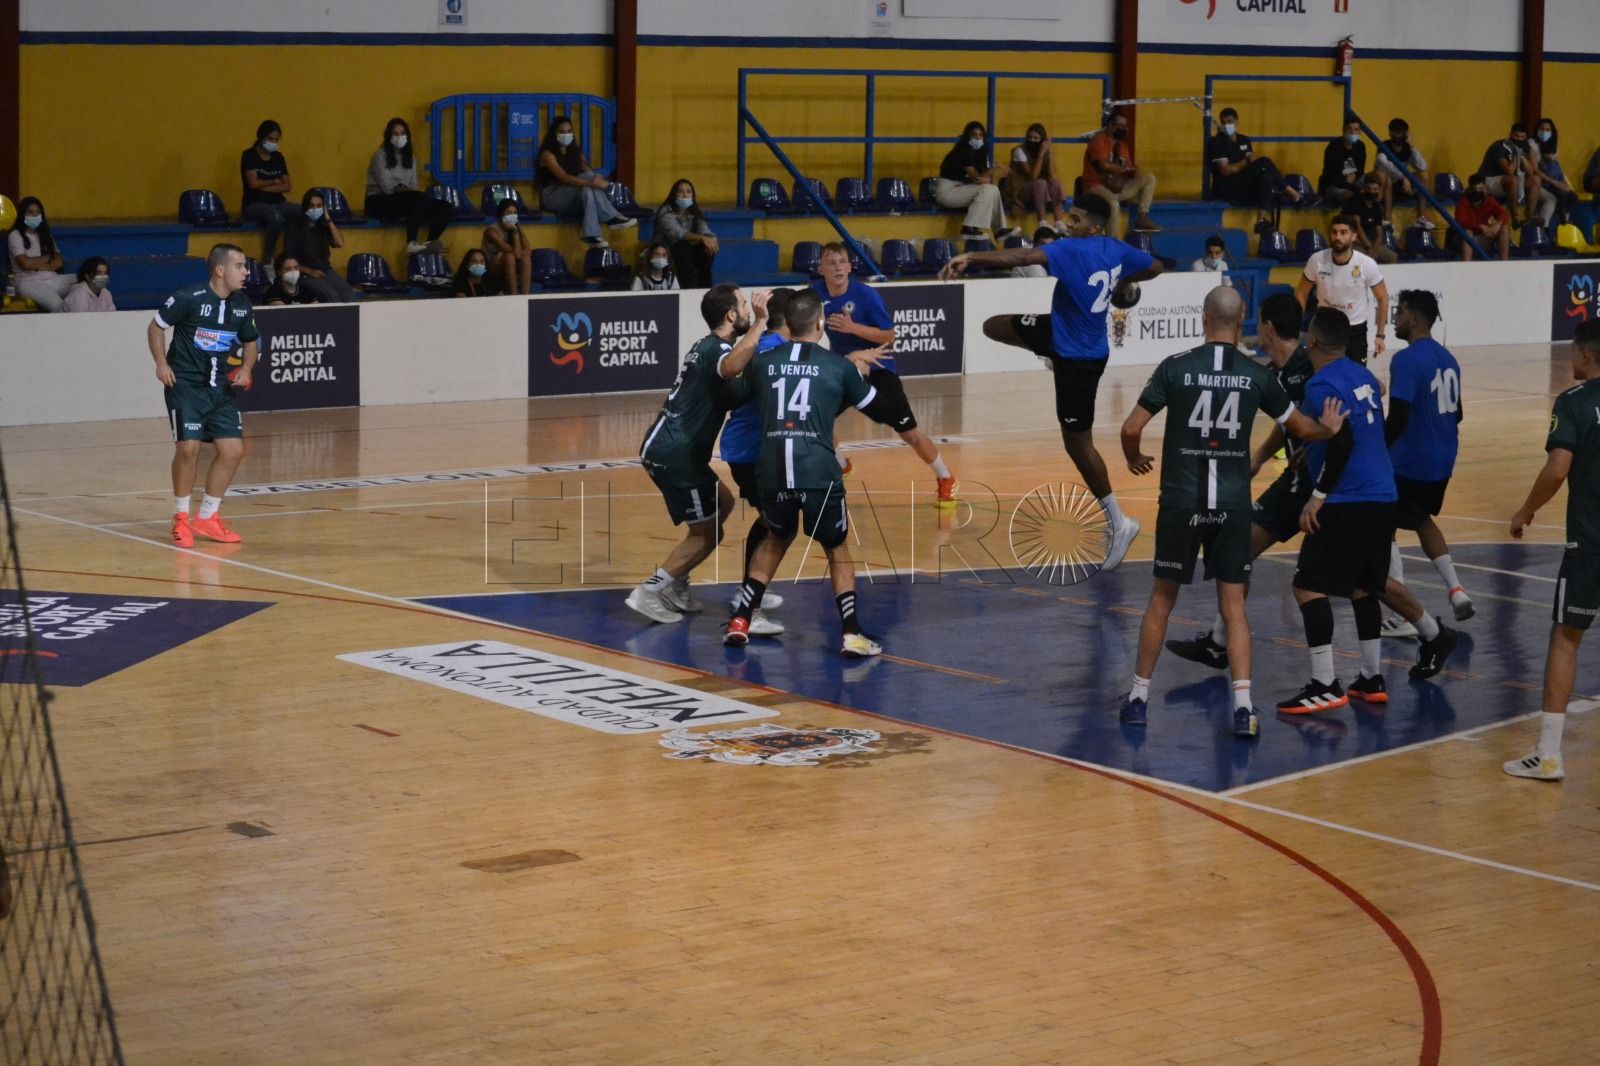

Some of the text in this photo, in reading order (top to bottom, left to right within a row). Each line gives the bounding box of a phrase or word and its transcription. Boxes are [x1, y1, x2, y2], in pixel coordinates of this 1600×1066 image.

[1237, 0, 1306, 13] CAPITAL
[200, 303, 213, 317] 10
[893, 308, 945, 323] MELILLA
[1138, 304, 1202, 316] CIUDAD AUTÓNO
[600, 320, 658, 335] MELILLA
[893, 323, 936, 338] SPORT
[1140, 317, 1205, 340] MELILL
[270, 333, 336, 350] MELILLA
[600, 335, 648, 351] SPORT
[893, 338, 945, 353] CAPITAL
[270, 350, 324, 367] SPORT
[600, 351, 658, 367] CAPITAL
[270, 366, 336, 383] CAPITAL
[768, 364, 820, 376] D. VENTAS
[1183, 373, 1252, 390] D. MARTINEZ
[771, 377, 812, 421] 14
[1430, 367, 1459, 415] 10
[1187, 389, 1242, 440] 44
[41, 601, 170, 640] CAPITAL
[431, 643, 750, 724] MELILLA
[536, 698, 660, 730] CIUDAD
